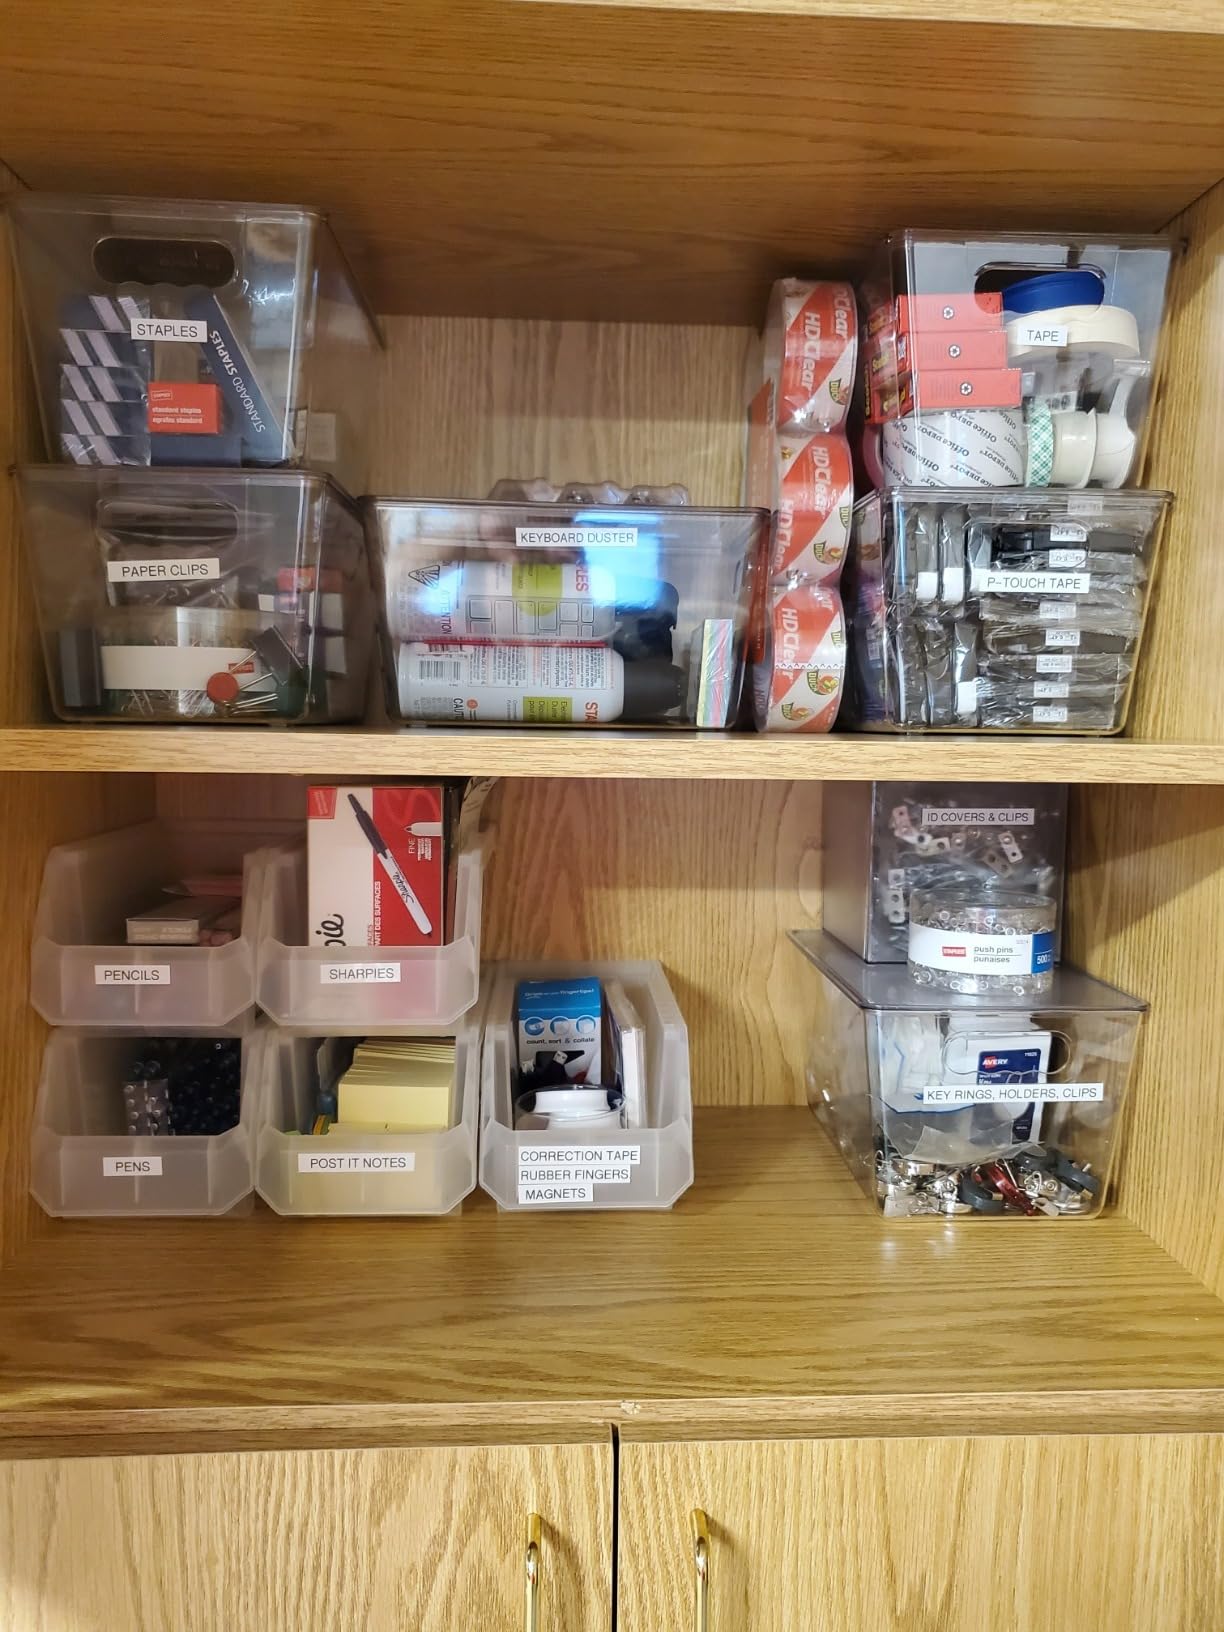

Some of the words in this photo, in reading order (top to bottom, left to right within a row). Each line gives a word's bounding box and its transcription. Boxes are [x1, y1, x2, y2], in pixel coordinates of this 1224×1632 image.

[136, 323, 198, 338] STAPLES
[1026, 329, 1060, 342] TAPE
[209, 329, 237, 376] STAPLES
[232, 376, 266, 433] STANDARD
[951, 411, 972, 427] DEPO
[973, 423, 997, 443] Office
[943, 437, 970, 457] Office
[520, 532, 584, 543] KEYBOARD
[587, 532, 634, 543] DUSTER
[121, 564, 167, 577] PAPER
[170, 563, 209, 576] CLIPS
[987, 577, 1047, 589] P-TOUCH
[1049, 577, 1081, 589] TAPE
[782, 607, 799, 680] HDCler
[927, 812, 938, 822] ID
[940, 812, 986, 822] COVERS
[988, 812, 996, 822] &
[998, 812, 1029, 822] CLIPS
[996, 946, 1014, 954] pins
[1036, 954, 1048, 964] 500
[104, 969, 160, 981] PENCILS
[329, 967, 395, 980] SHARPIES
[982, 1058, 1009, 1066] AVERY
[927, 1090, 951, 1101] KEY
[954, 1088, 995, 1101] RINGS,
[999, 1087, 1059, 1100] HOLDERS,
[1062, 1087, 1097, 1098] CLIPS
[520, 1150, 603, 1162] CORRECTION
[608, 1150, 638, 1161] TAPE
[115, 1161, 151, 1173] PENS
[310, 1158, 345, 1169] POST
[348, 1158, 361, 1169] IT
[364, 1157, 407, 1169] NOTES
[520, 1169, 571, 1181] RUBBER
[574, 1168, 629, 1180] FINGERS
[525, 1188, 586, 1199] MAGNETS
